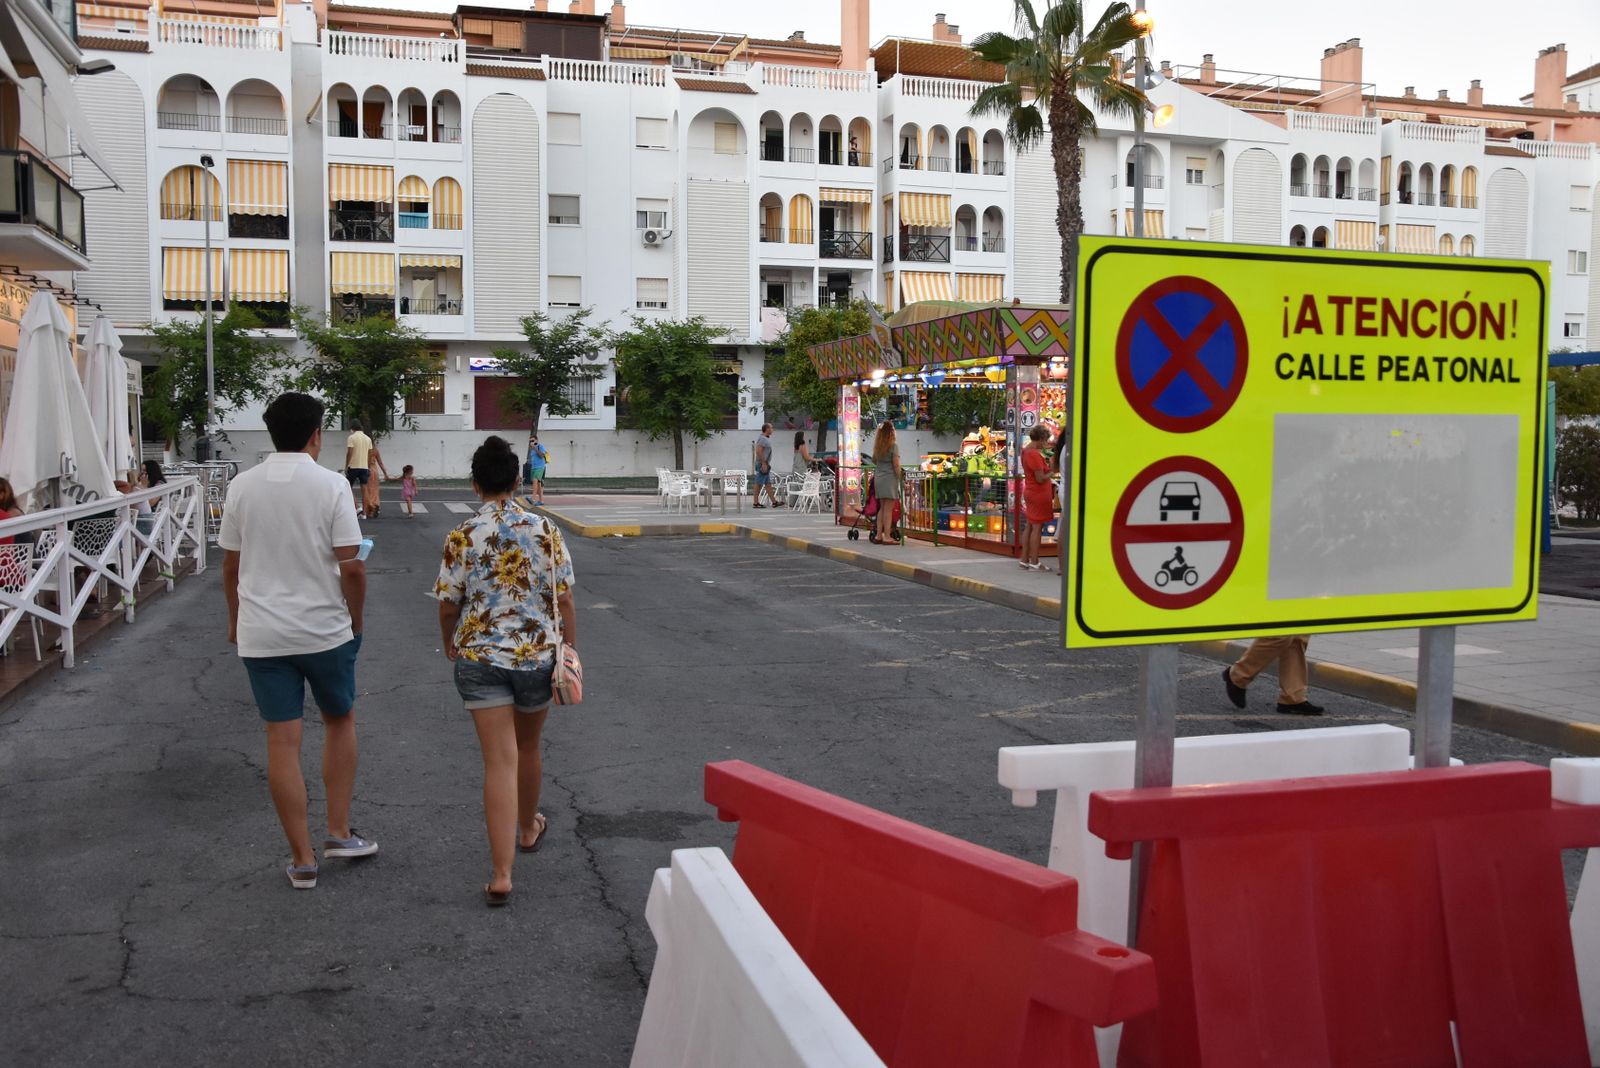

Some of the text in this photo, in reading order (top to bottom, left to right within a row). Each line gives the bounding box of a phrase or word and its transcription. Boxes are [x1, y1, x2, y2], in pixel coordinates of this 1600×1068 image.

[10, 286, 32, 305] FON
[1282, 291, 1518, 340] ¡ATENCIÓN!
[1275, 352, 1521, 383] CALLE PEATONAL
